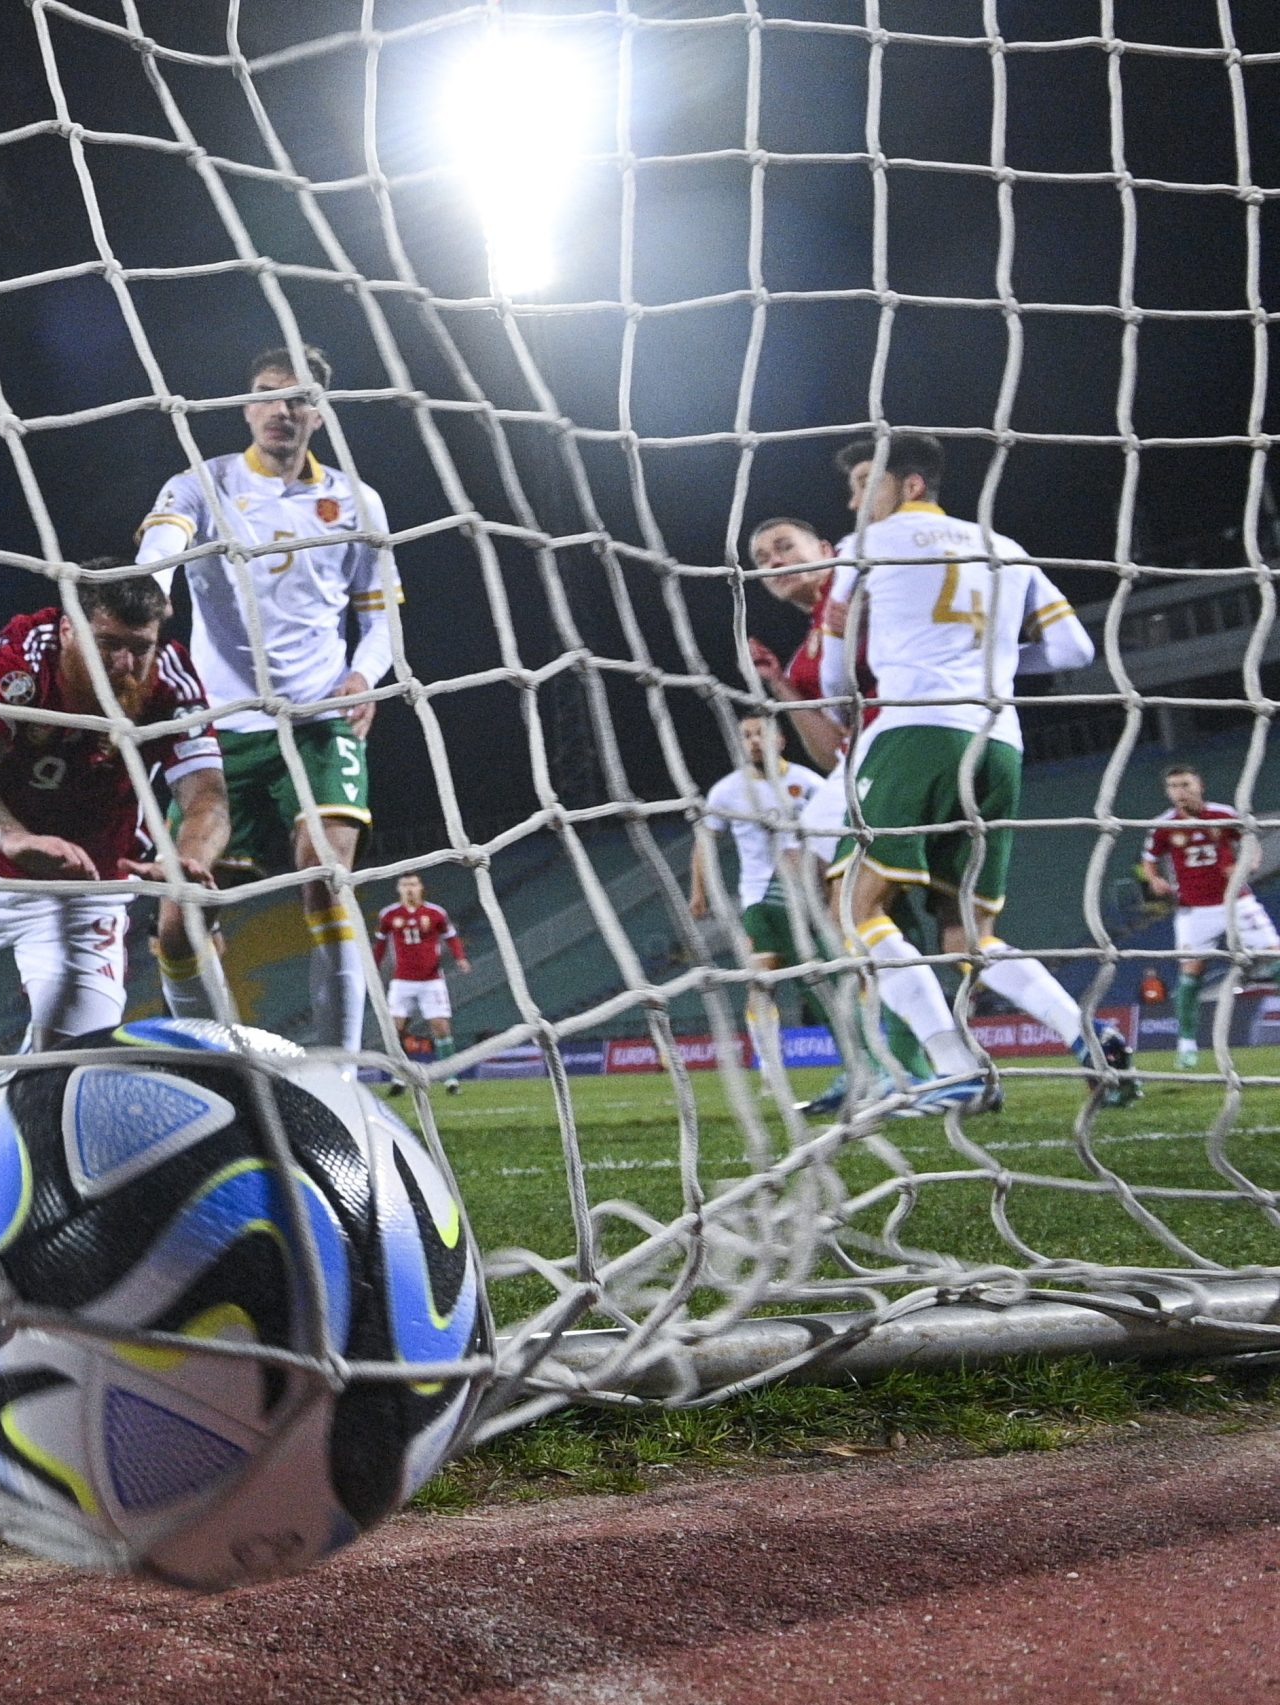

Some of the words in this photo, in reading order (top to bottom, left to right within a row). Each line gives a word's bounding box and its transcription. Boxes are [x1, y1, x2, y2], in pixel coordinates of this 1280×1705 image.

[269, 530, 297, 574] 5
[932, 550, 986, 650] 4
[29, 756, 67, 790] 9
[335, 735, 361, 776] 5
[1184, 843, 1219, 868] 23
